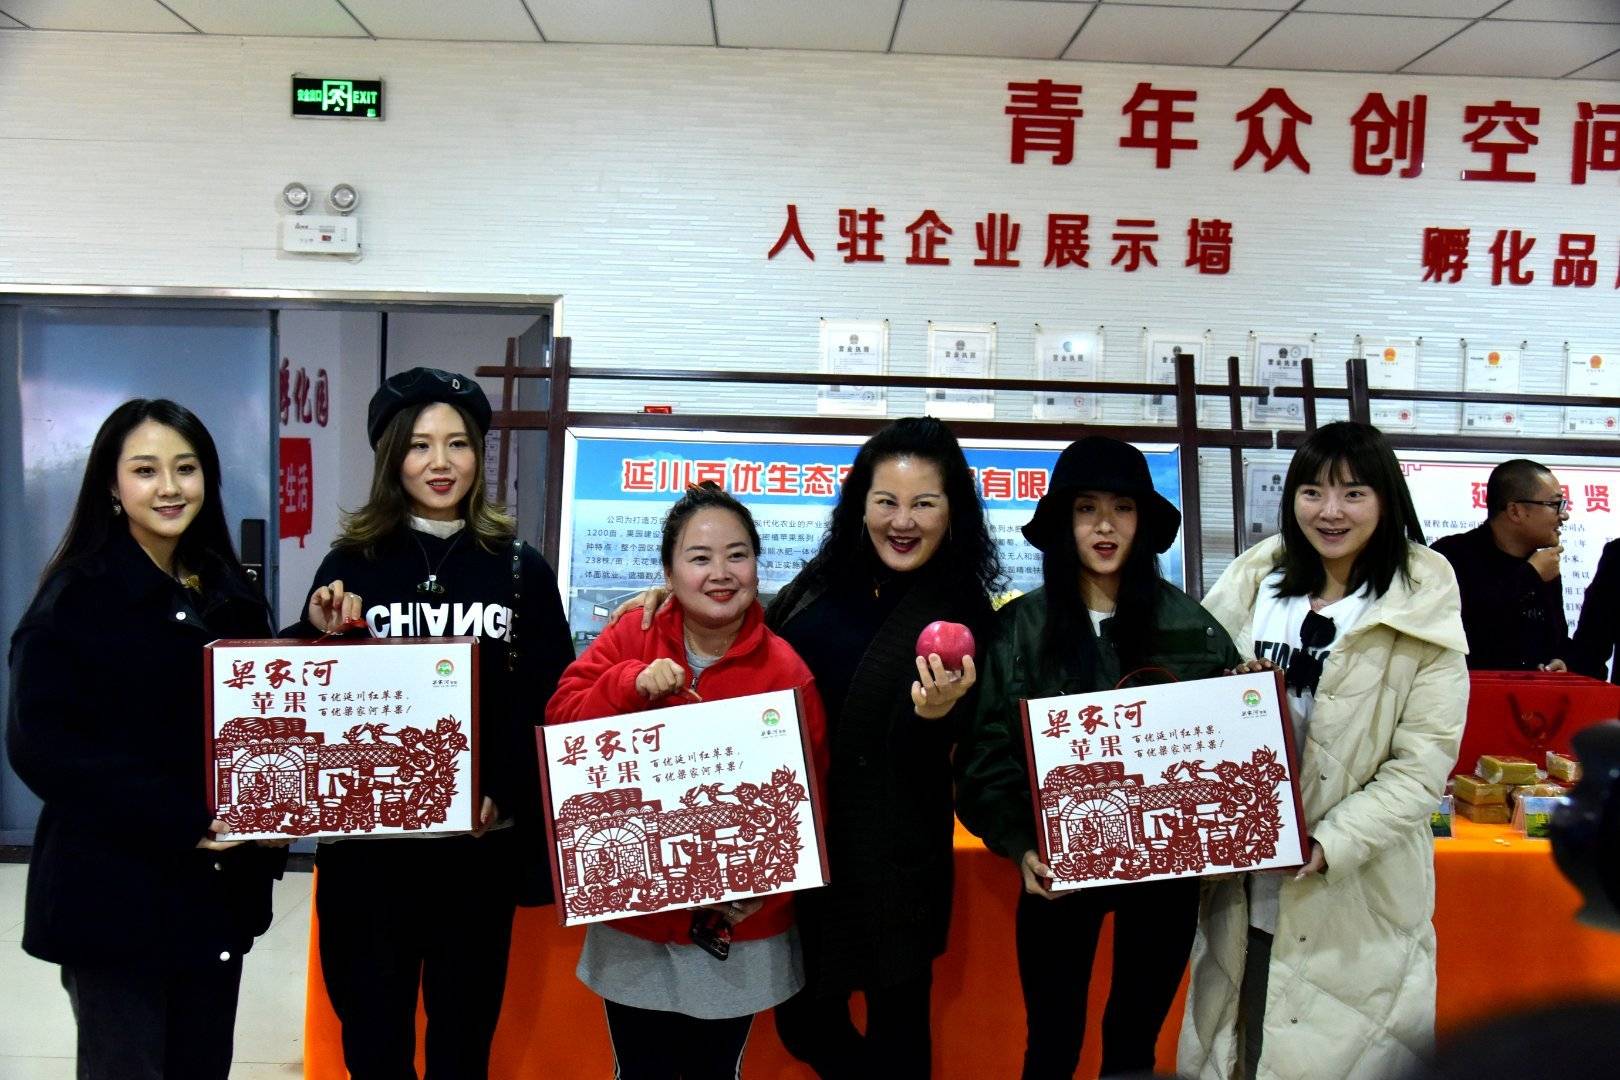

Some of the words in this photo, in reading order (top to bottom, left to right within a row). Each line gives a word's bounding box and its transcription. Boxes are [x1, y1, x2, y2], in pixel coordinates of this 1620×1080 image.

[352, 90, 377, 104] EXIT
[1004, 78, 1620, 186] 青年众创空间
[767, 203, 1235, 276] 入驻企业展示墙
[1421, 226, 1620, 290] 孵化品
[279, 463, 308, 513] 生活
[223, 658, 339, 690] 梁家河
[251, 691, 307, 715] 苹果
[1041, 700, 1147, 739] 梁家河
[556, 723, 666, 766] 梁家河
[1069, 735, 1123, 761] 苹果
[585, 760, 641, 789] 苹果
